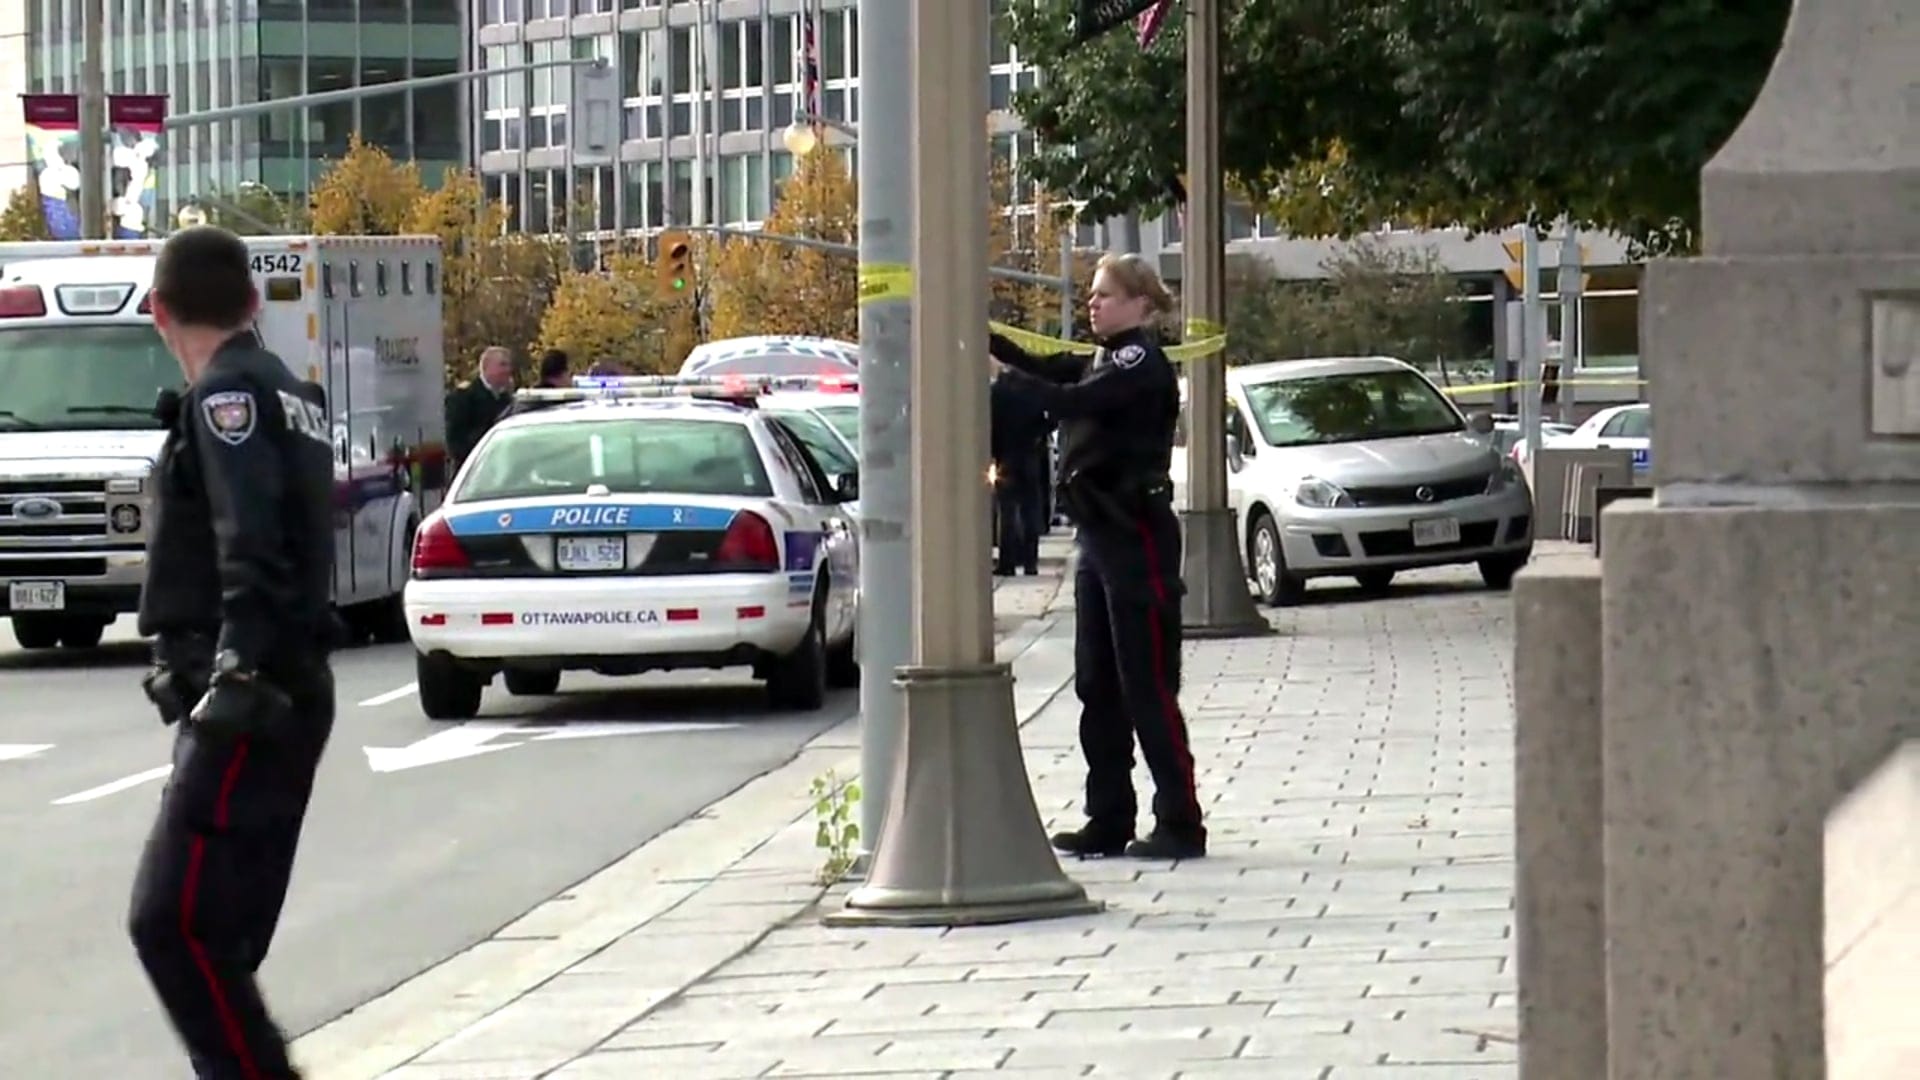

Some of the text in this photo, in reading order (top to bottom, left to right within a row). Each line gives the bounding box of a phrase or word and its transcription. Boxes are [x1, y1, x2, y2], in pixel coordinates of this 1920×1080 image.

[251, 254, 302, 273] 4542
[551, 508, 630, 525] POLICE
[521, 610, 658, 625] OTTAWAPOLICE.CA
